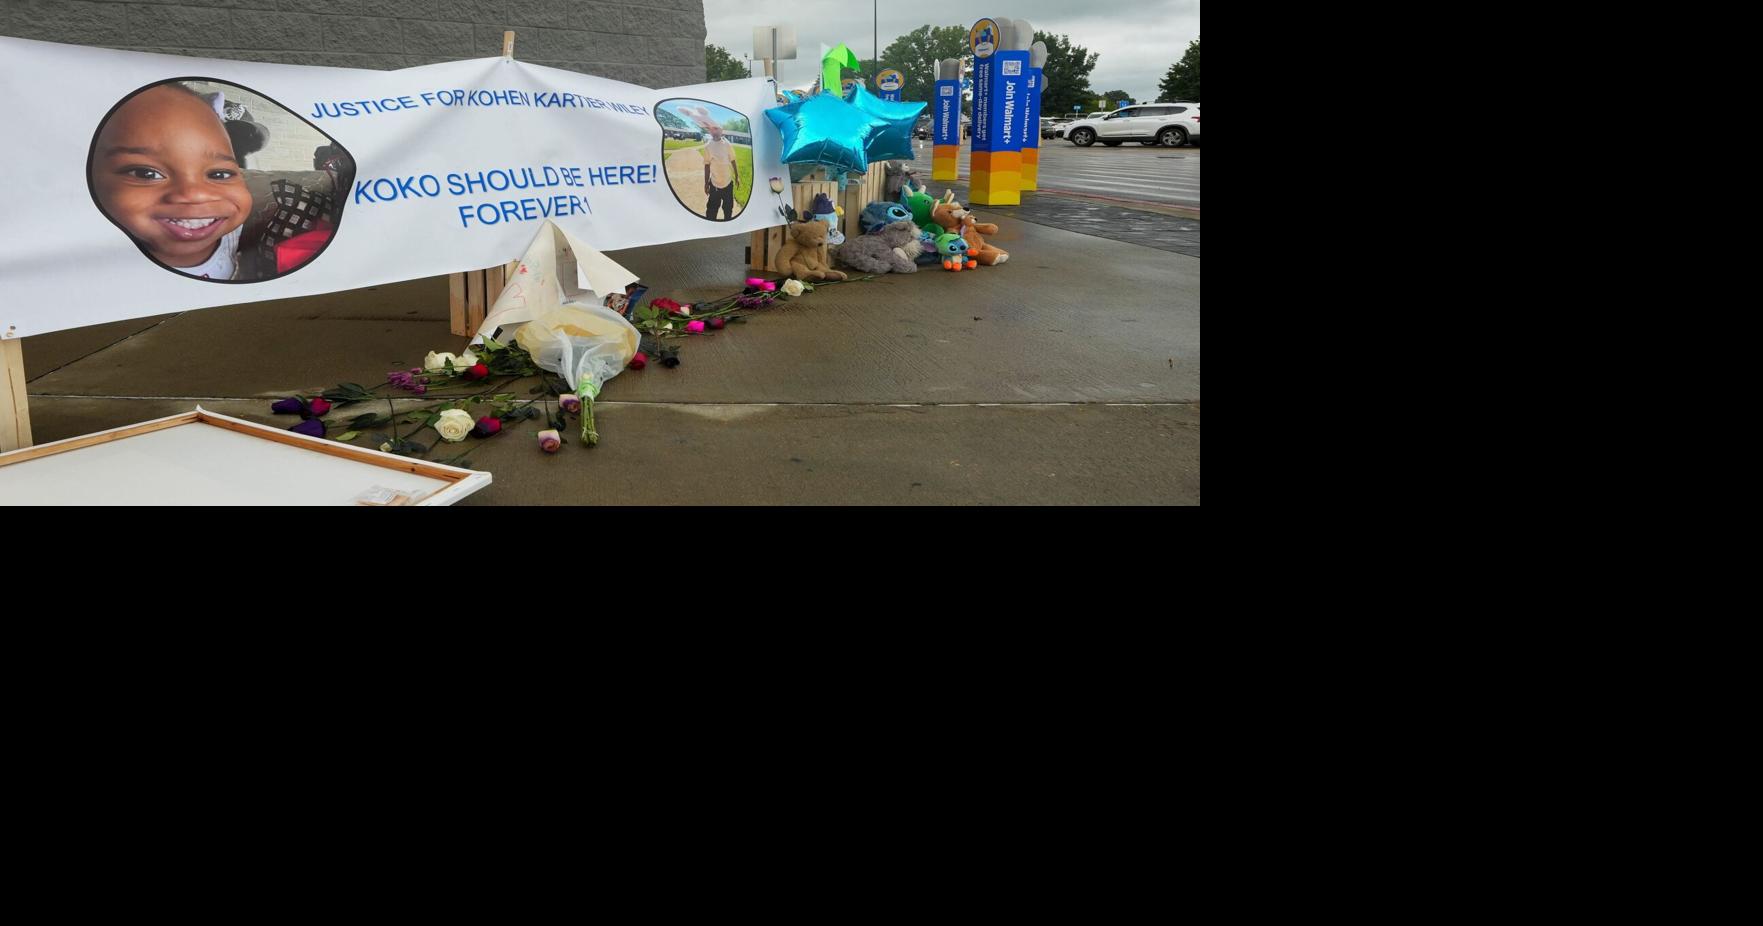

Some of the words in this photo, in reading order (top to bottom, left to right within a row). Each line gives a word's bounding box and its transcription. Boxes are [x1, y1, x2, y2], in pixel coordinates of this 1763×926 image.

[311, 96, 419, 118] JUSTICE
[420, 89, 465, 106] FOR
[467, 90, 530, 106] KOHEN
[534, 92, 611, 110] KARTIER
[610, 102, 650, 116] WILEY
[942, 99, 950, 111] Join
[1005, 81, 1015, 100] Join
[942, 111, 950, 141] Walmart+
[1002, 100, 1015, 144] Walmart+
[354, 174, 441, 204] KOKO
[447, 166, 559, 195] SHOULD
[560, 167, 584, 187] BE
[588, 164, 657, 187] HERE!
